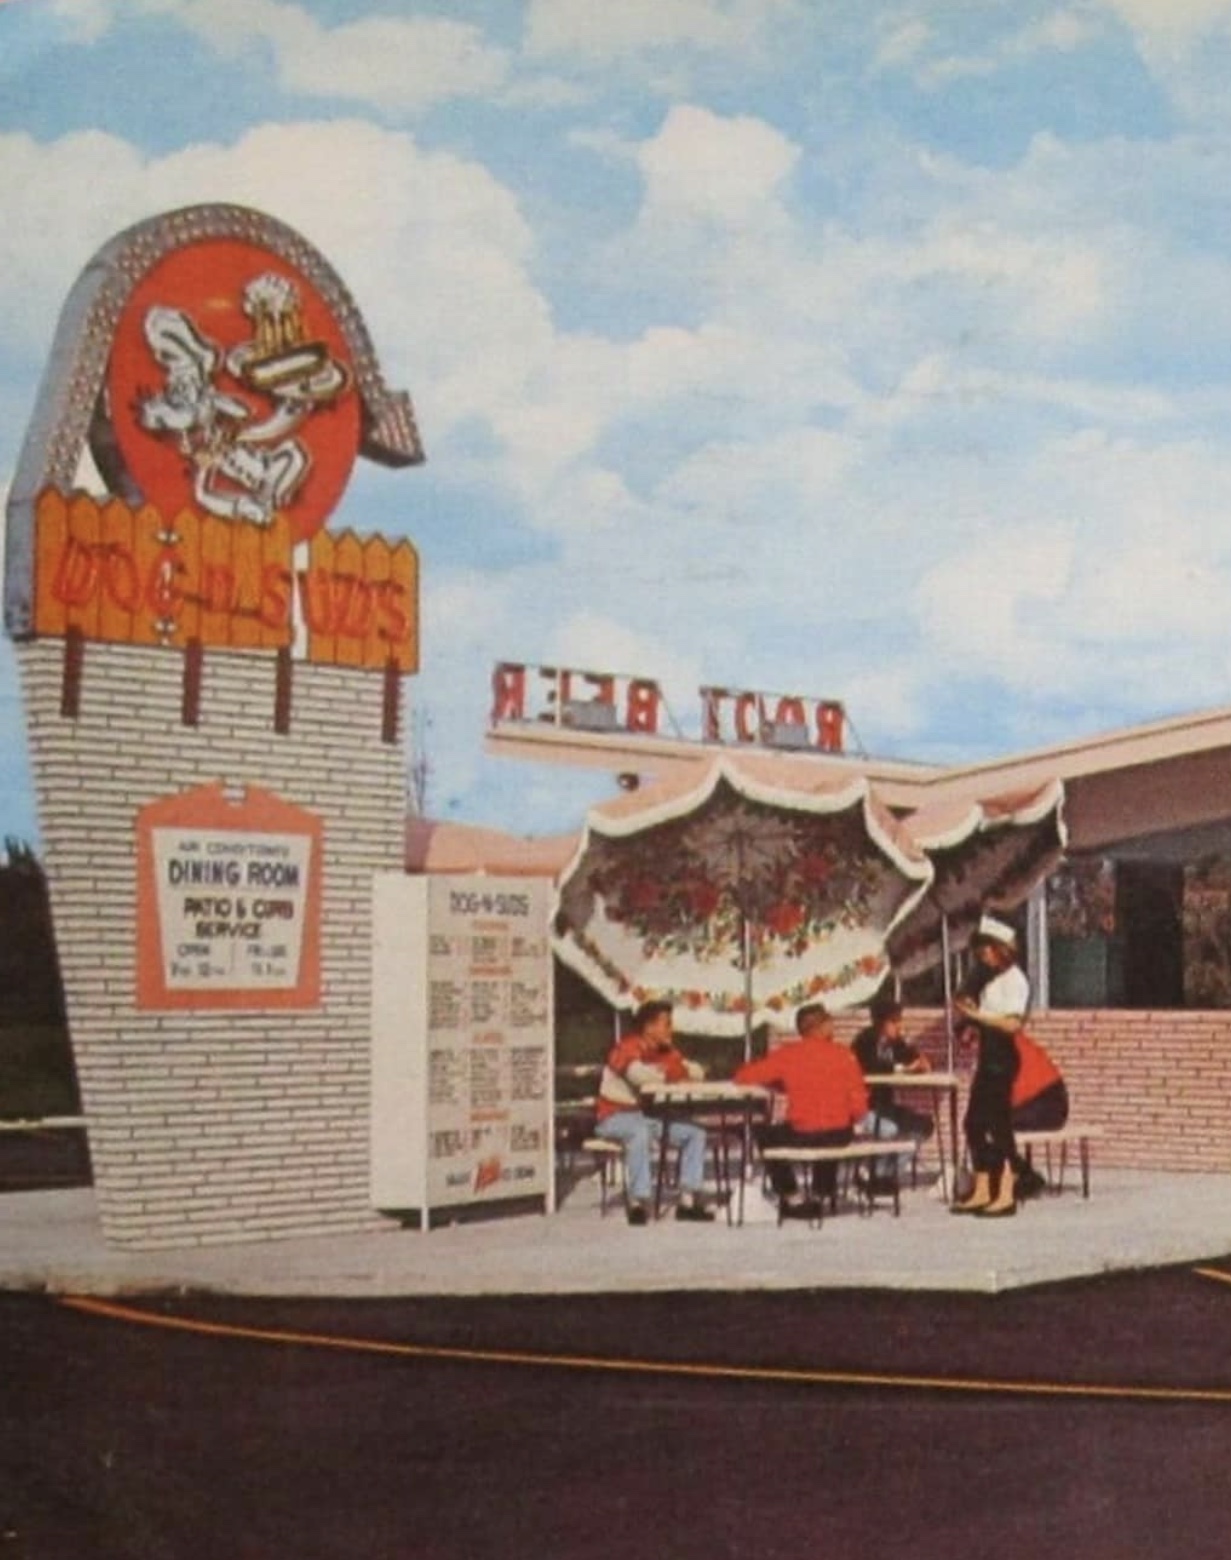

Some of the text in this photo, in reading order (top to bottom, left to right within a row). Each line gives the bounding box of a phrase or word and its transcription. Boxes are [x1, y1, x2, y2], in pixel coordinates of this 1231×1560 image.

[168, 859, 300, 887] DINING ROOM
[183, 897, 231, 919] PATIO
[252, 899, 294, 920] CURB
[195, 920, 262, 939] SERVICE
